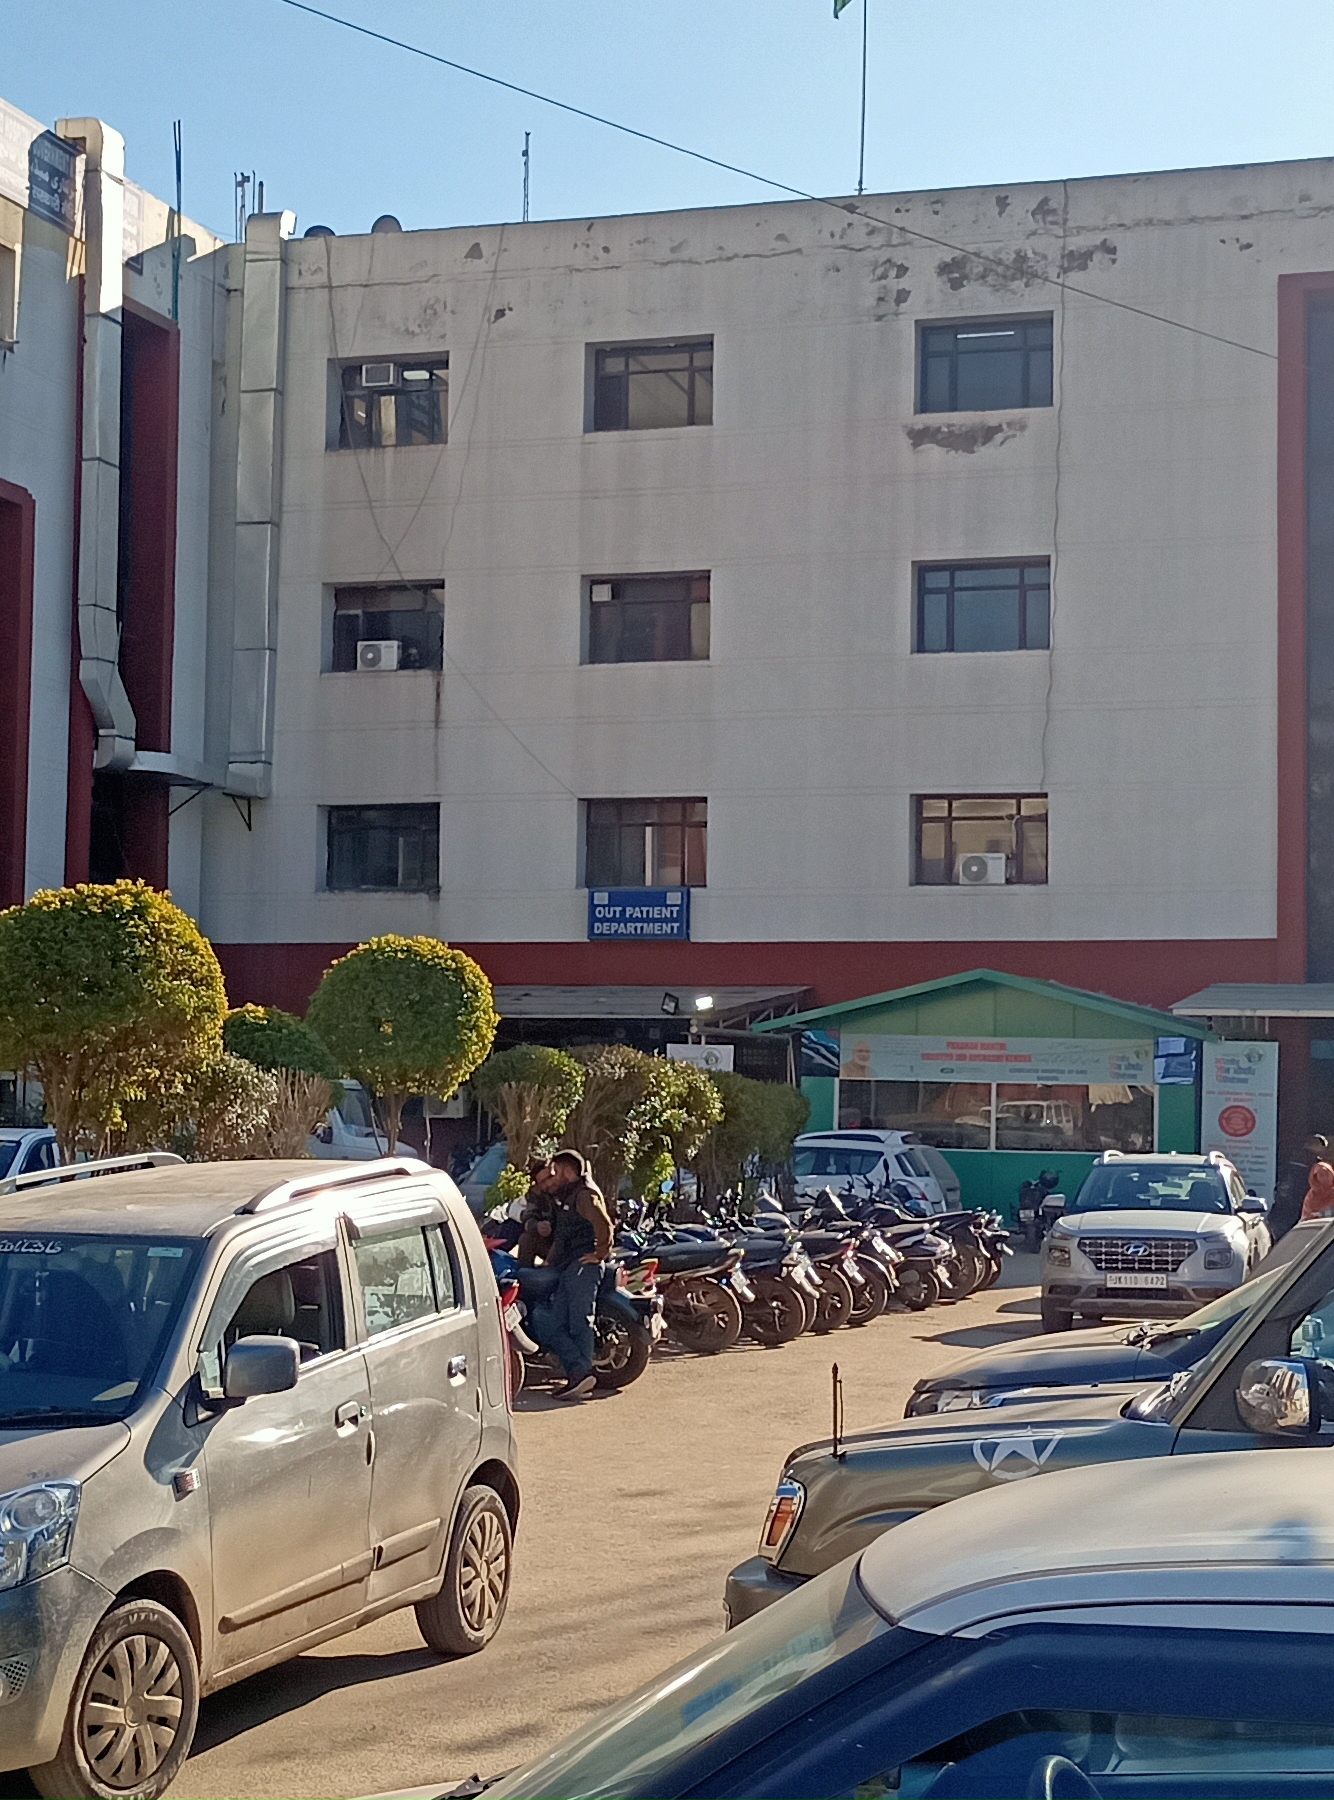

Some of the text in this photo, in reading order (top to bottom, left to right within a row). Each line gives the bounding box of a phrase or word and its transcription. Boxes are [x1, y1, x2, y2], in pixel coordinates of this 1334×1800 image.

[595, 906, 680, 918] OUT PATIENT
[593, 922, 680, 934] DEPARTMENT
